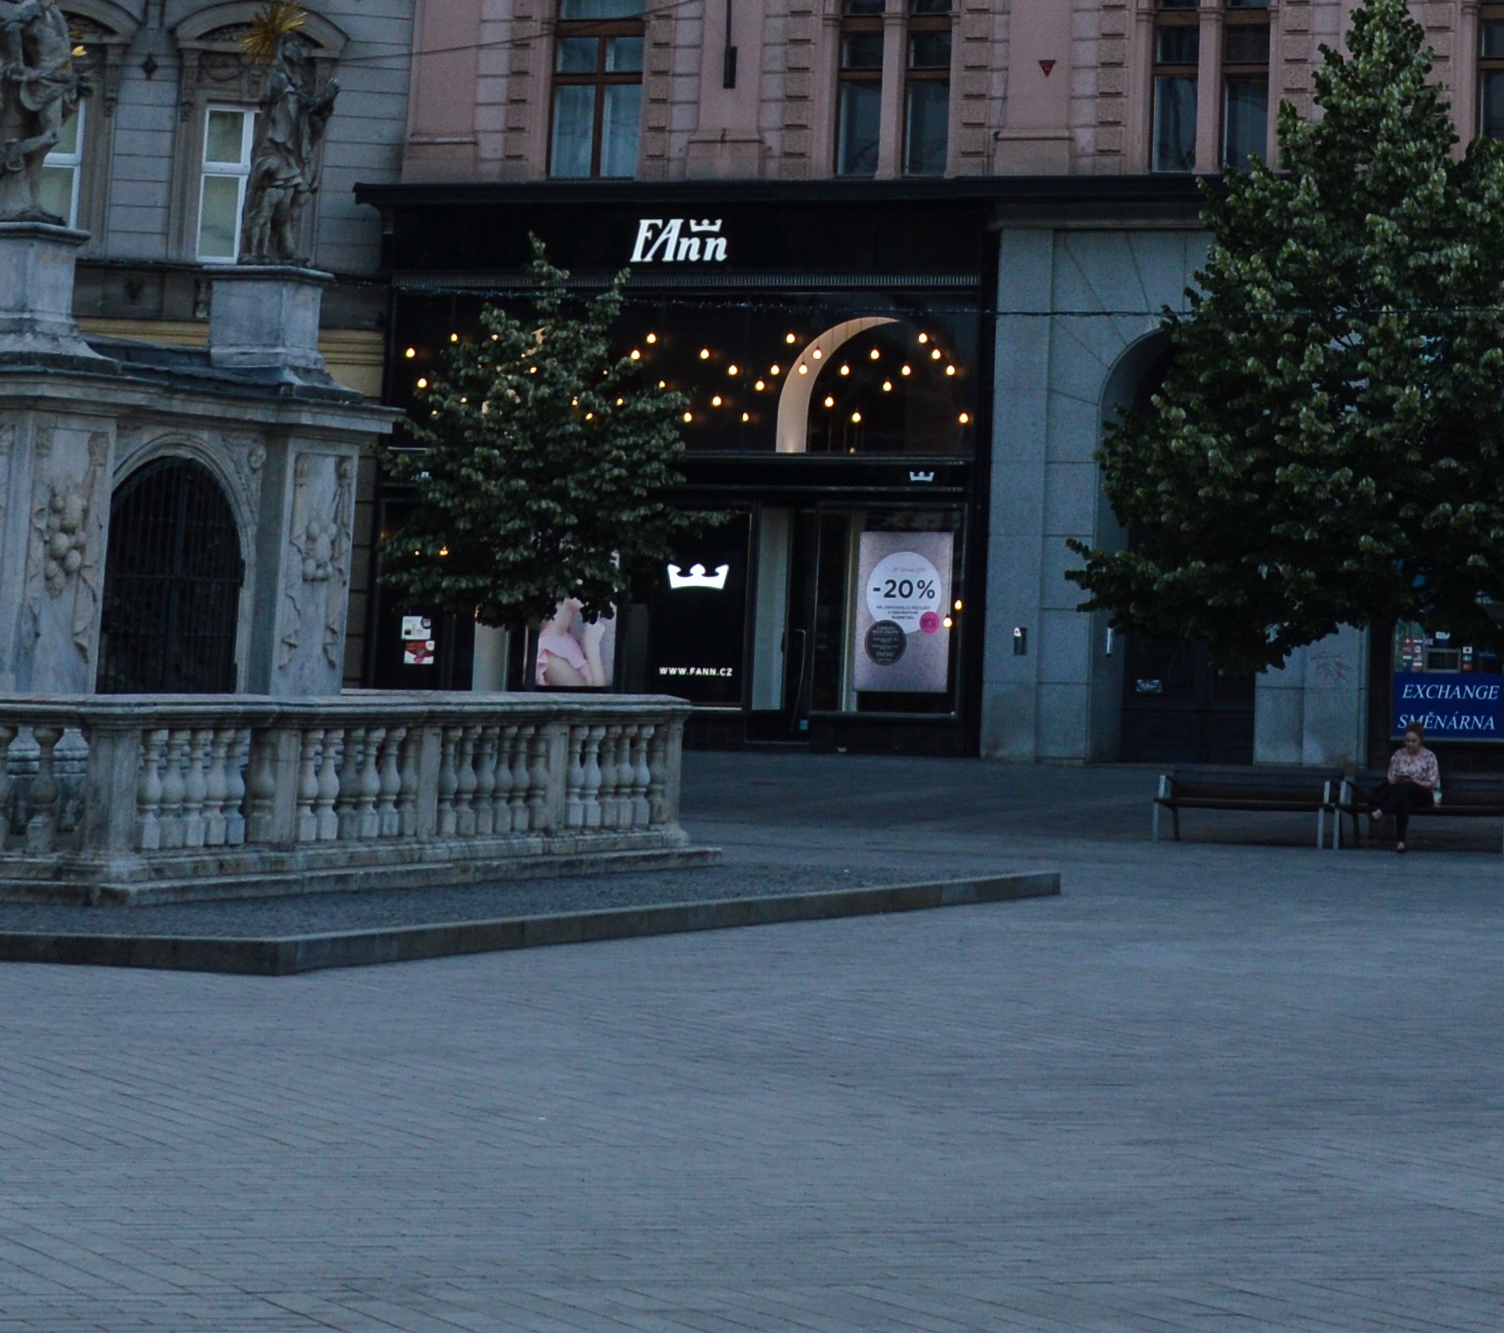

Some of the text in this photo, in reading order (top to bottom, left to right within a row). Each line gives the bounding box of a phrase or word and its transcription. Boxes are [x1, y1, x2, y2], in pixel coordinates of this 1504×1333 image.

[659, 666, 734, 677] WWW.FANN.CZ
[1402, 684, 1500, 700] EXCHANGE
[1398, 711, 1496, 731] SMĚNÁRNA
